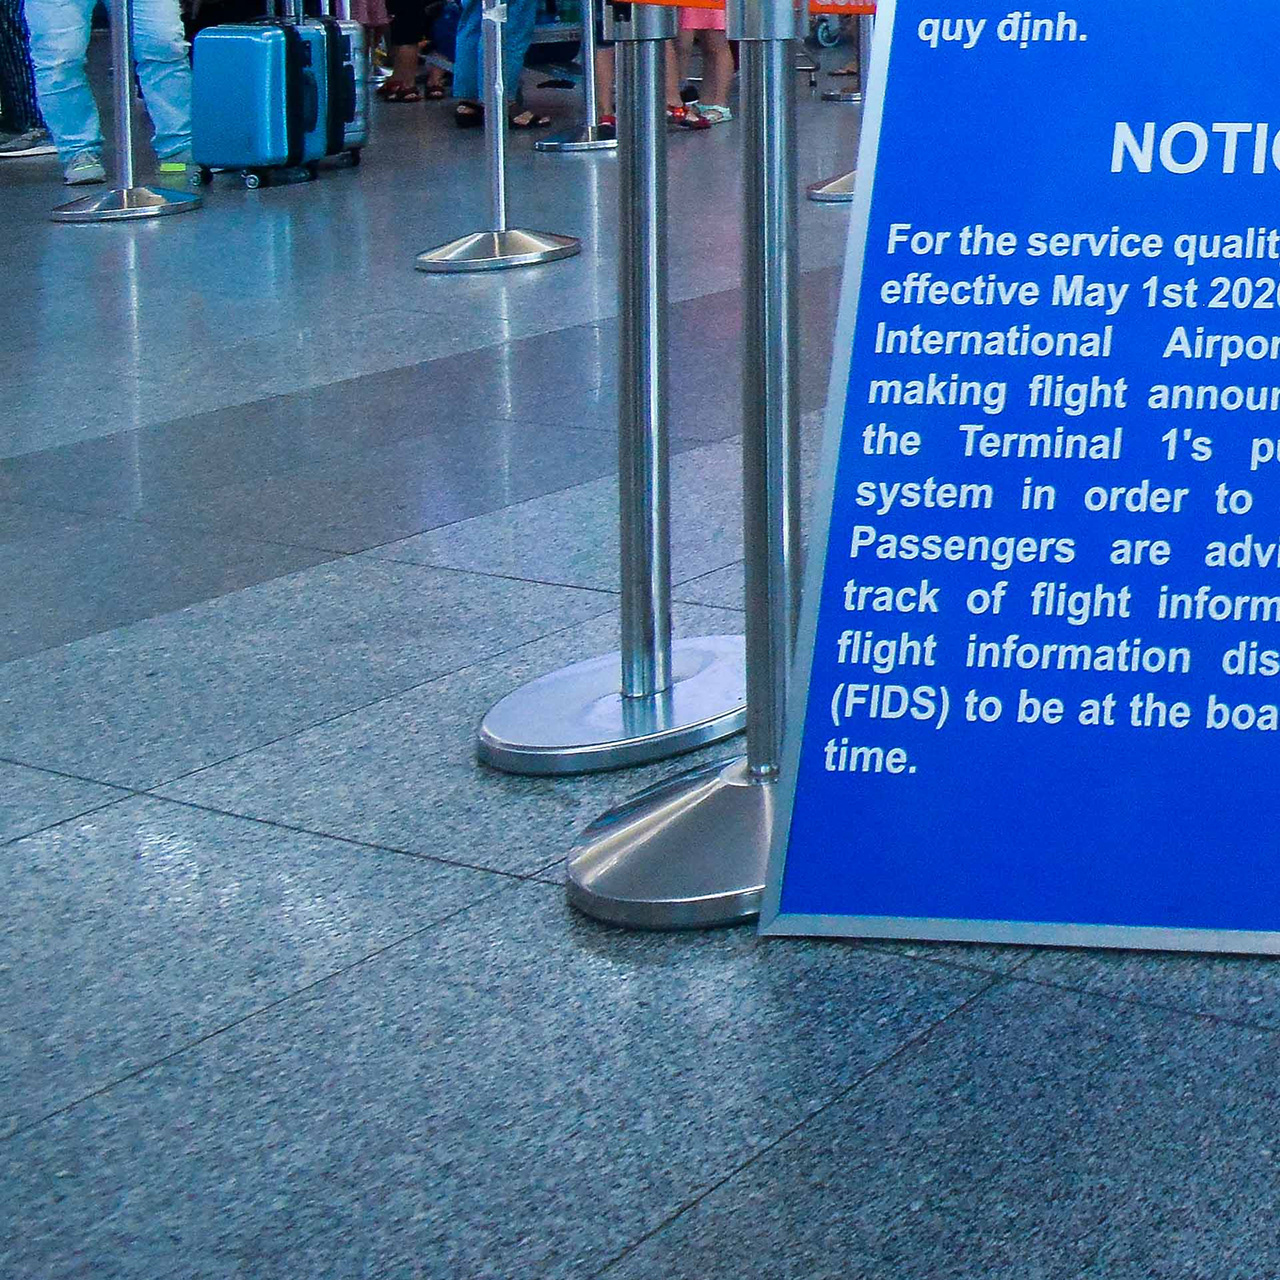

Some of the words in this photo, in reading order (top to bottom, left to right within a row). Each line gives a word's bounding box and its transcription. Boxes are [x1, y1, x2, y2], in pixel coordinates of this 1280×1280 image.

[918, 19, 986, 48] quy
[997, 11, 1087, 48] định.
[887, 224, 951, 254] For
[959, 225, 1017, 255] the
[1027, 226, 1163, 257] service
[881, 273, 1039, 305] effective
[1052, 275, 1129, 315] May
[1143, 276, 1198, 308] 1st
[831, 683, 949, 729] (FIDS)
[965, 689, 1002, 722] to
[1017, 689, 1063, 724] be
[1078, 693, 1116, 725] at
[1130, 693, 1190, 728] the
[824, 738, 916, 773] time.
